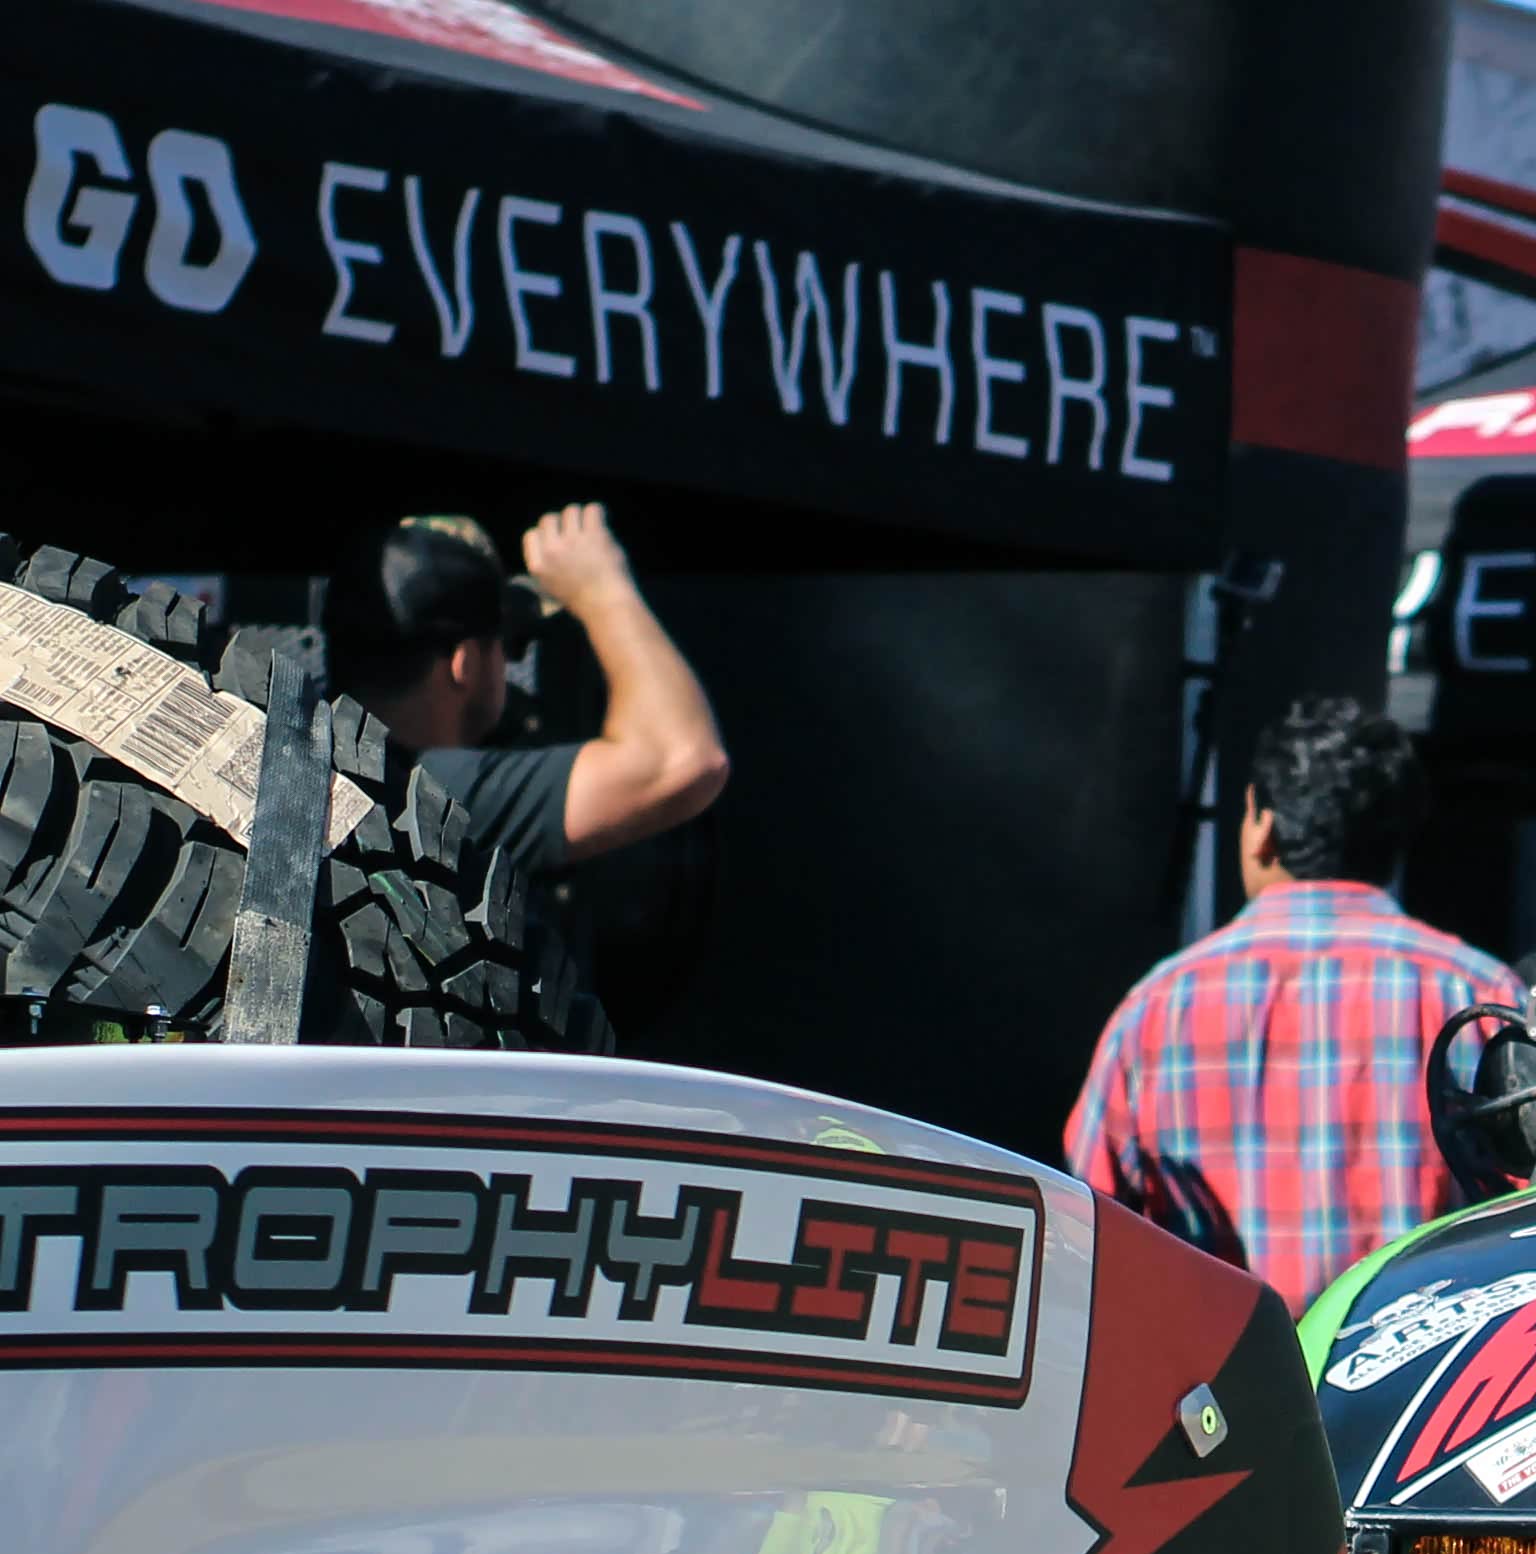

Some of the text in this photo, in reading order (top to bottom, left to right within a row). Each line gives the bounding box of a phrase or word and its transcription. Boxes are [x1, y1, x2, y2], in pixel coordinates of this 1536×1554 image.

[25, 103, 1179, 481] GO EVERYWHERE
[0, 1174, 1024, 1348] TROPHYLITE
